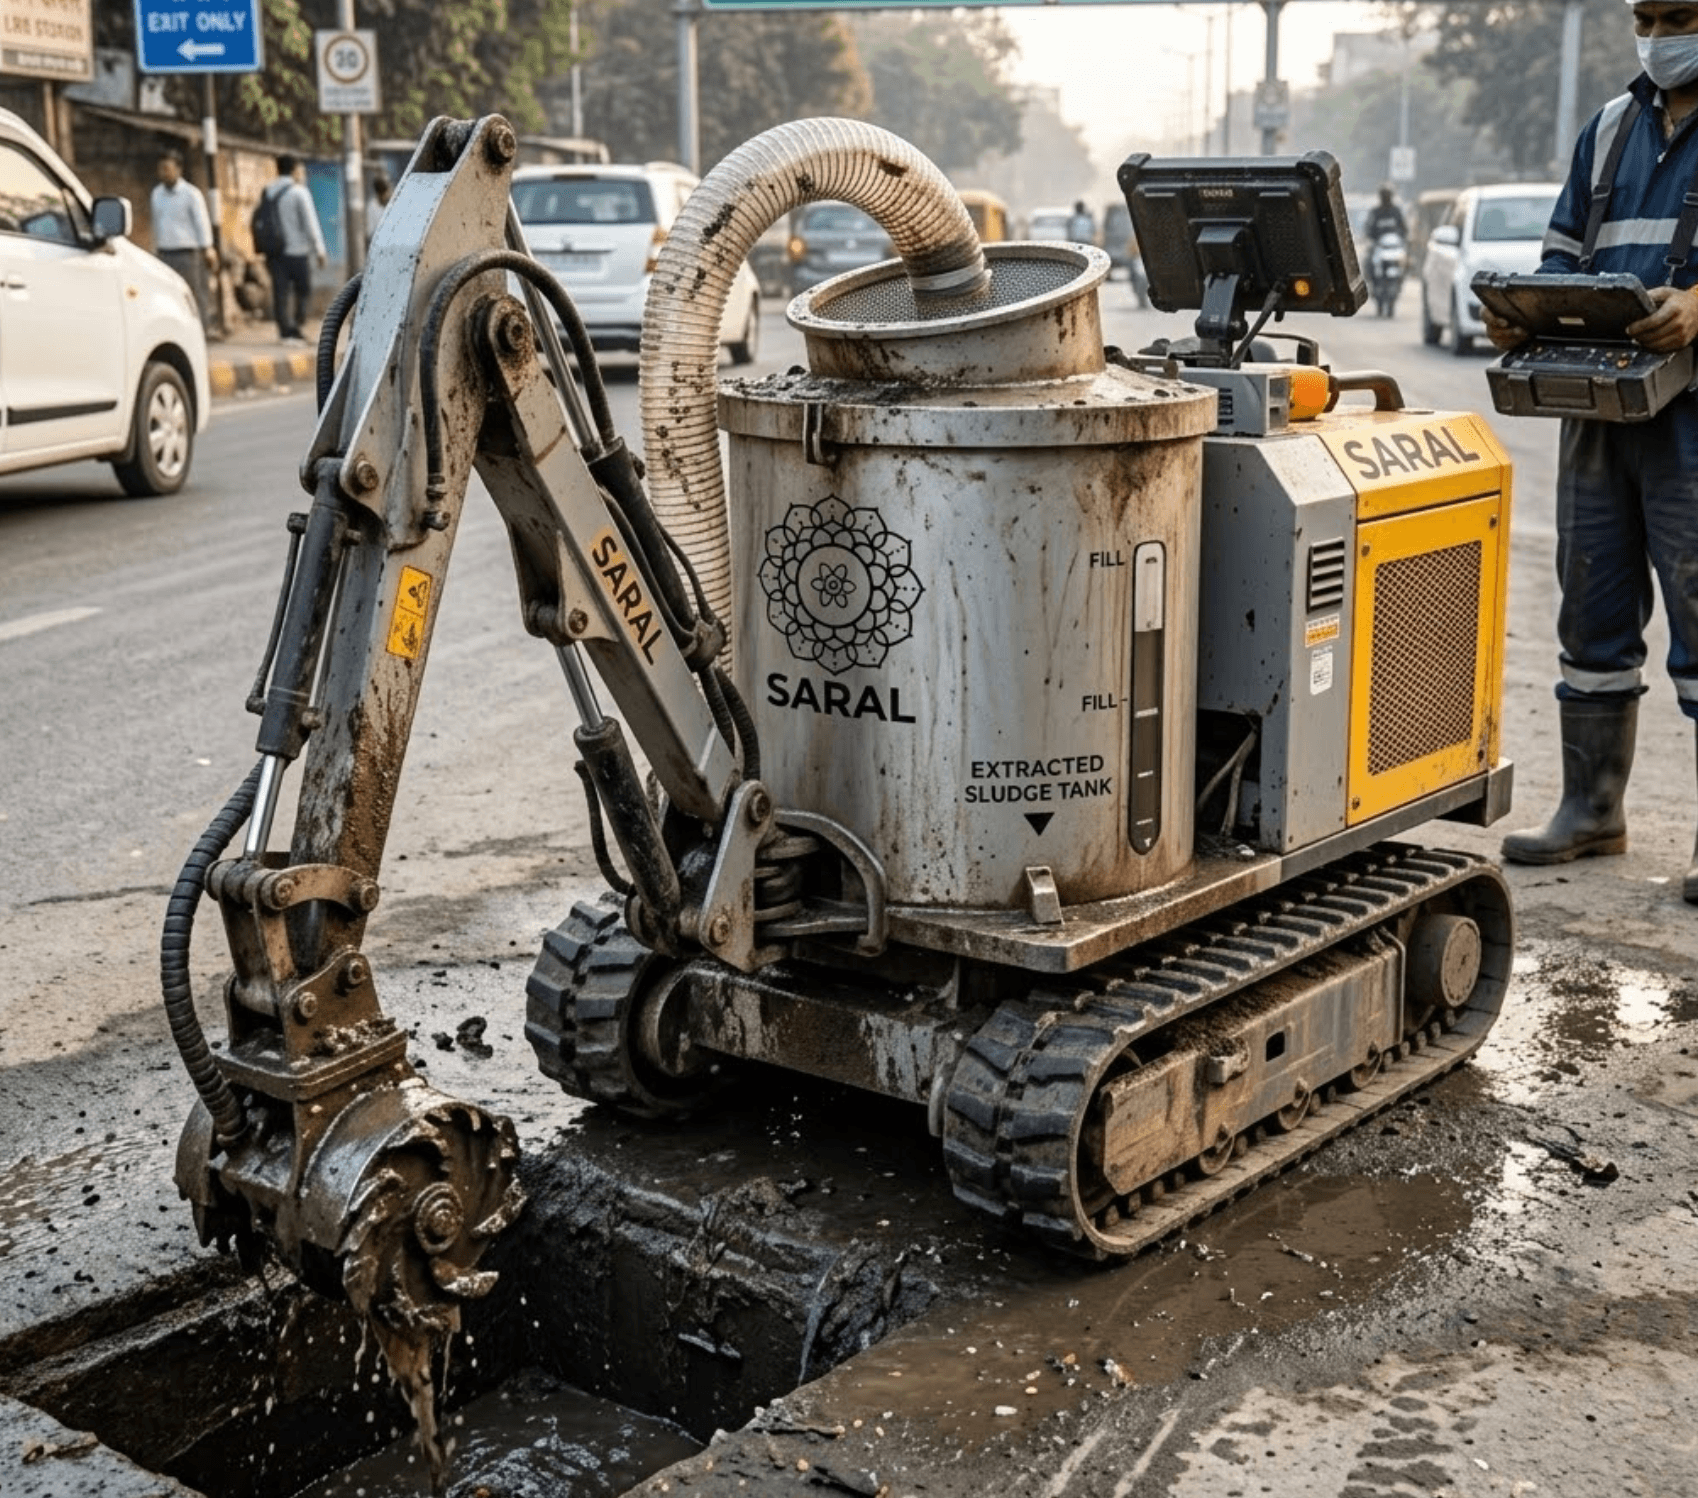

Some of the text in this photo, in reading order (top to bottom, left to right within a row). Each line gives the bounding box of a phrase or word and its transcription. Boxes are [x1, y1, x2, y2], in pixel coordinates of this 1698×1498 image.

[195, 10, 247, 33] ONLY
[1343, 426, 1481, 480] SARAL
[1089, 551, 1126, 569] FILL
[592, 534, 663, 666] SARAL
[766, 672, 917, 724] SARAL
[1081, 693, 1118, 712] FILL
[971, 754, 1105, 779] EXTRACTED
[964, 777, 1112, 803] SLUDGE TANK
